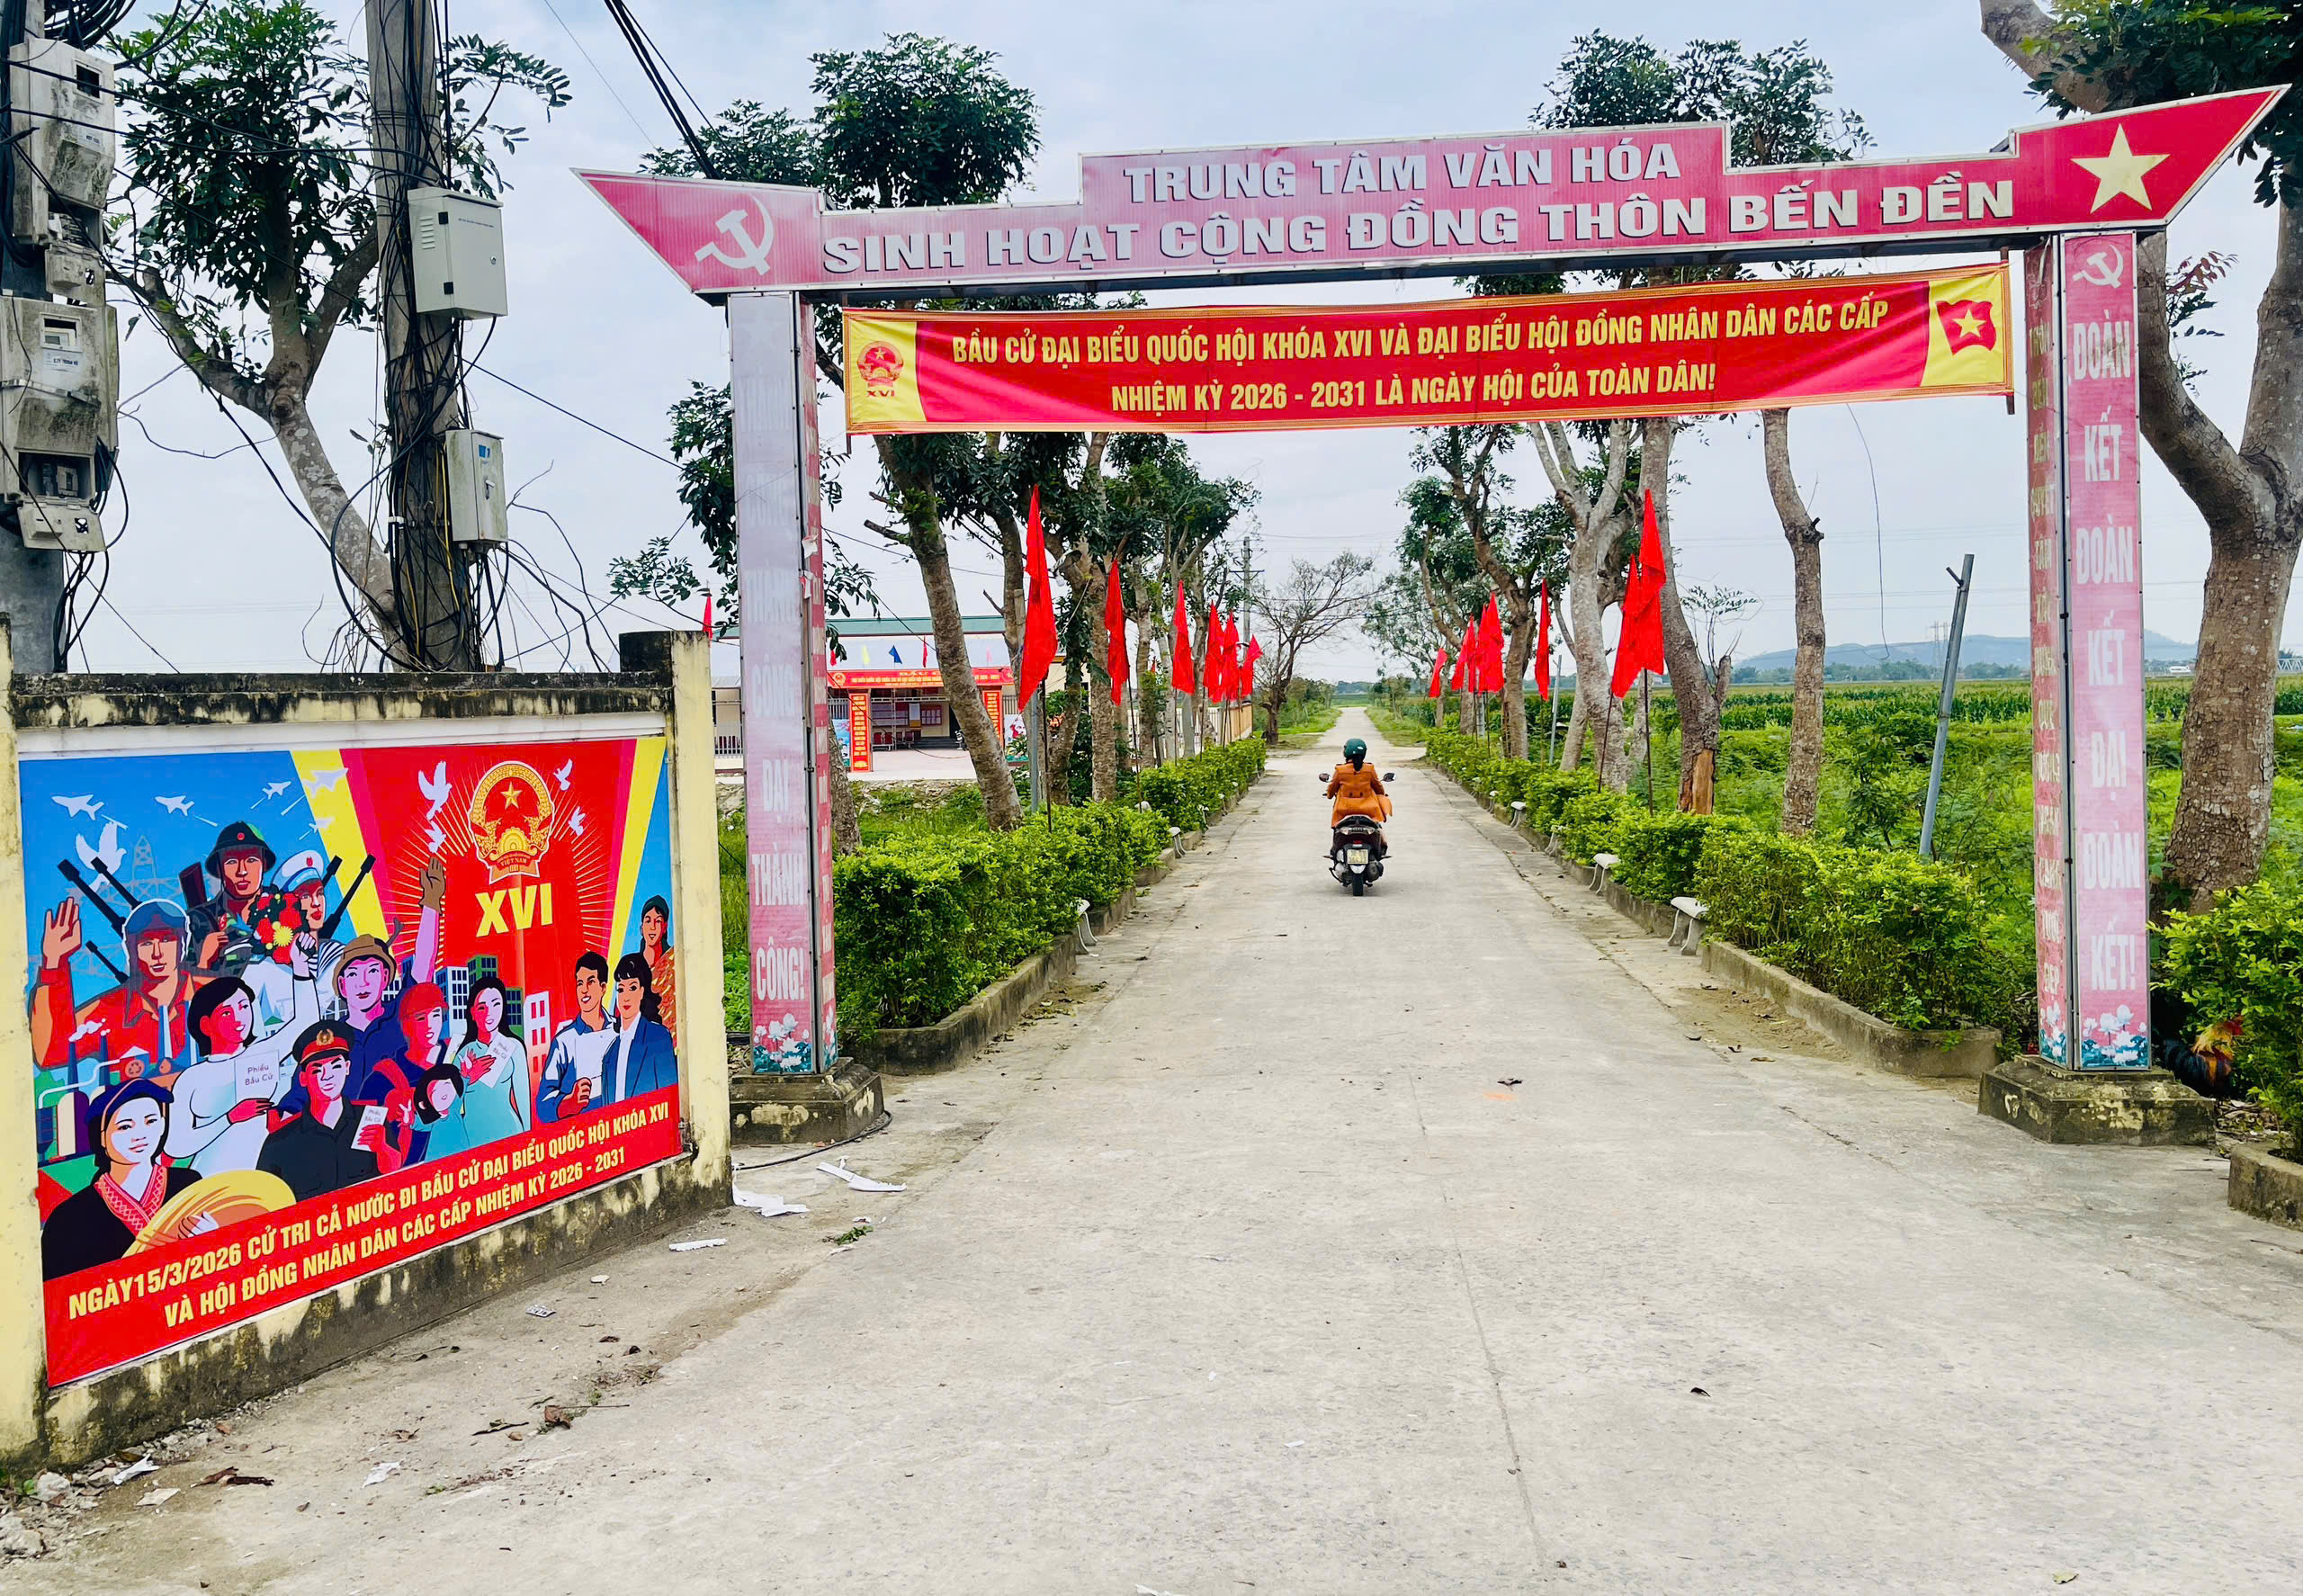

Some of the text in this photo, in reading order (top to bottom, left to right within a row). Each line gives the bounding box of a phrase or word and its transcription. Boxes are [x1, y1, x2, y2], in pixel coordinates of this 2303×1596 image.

[1124, 138, 1681, 203] TRUNG TÂM VĂN HÓA
[823, 171, 2014, 273] SINH HOẠT CỘNG ĐỒNG THÔN BẾN ĐỀN
[952, 291, 1888, 369] BẦU CỬ ĐẠI BIỂU QUỐC HỘI KHÓA XVI VÀ ĐẠI BIỂU HỘI ĐỒNG NHÂN DÂN CÁC CẤP
[2072, 309, 2131, 381] ĐOÀN
[1112, 380, 1187, 417] NHIỆM
[1194, 379, 1223, 411] KỲ
[1231, 382, 1287, 410] 2026
[1311, 381, 1365, 408] 2031
[1376, 373, 1404, 406] LÀ
[1411, 371, 1476, 404] NGÀY
[1483, 368, 1523, 406] HỘI
[1530, 362, 1579, 399] CỦA
[1586, 362, 1650, 397] TOÀN
[1656, 359, 1716, 393] DÂN!
[2083, 405, 2122, 483] KẾT
[2075, 513, 2134, 584] ĐOÀN
[2087, 609, 2126, 686] KẾT
[762, 758, 790, 824] ĐẠI
[2091, 730, 2128, 801] ĐẠI
[751, 841, 806, 906] THÀNH
[2083, 820, 2141, 890] ĐOÀN
[475, 883, 552, 937] XVI
[756, 936, 805, 1001] CÔNG!
[2091, 915, 2137, 991] KẾT!
[245, 1076, 260, 1086] Bầu
[247, 1063, 269, 1074] Phiếu
[247, 1224, 277, 1260] CỬ
[280, 1219, 311, 1249] TRI
[316, 1204, 343, 1237] CẢ
[346, 1192, 395, 1228] NƯỚC
[399, 1185, 417, 1210] ĐI
[421, 1170, 454, 1202] BẦU
[458, 1158, 481, 1188] CỬ
[482, 1154, 508, 1181] ĐẠI
[512, 1138, 545, 1171] BIỂU
[548, 1125, 585, 1160] QUỐC
[587, 1119, 610, 1145] HỘI
[613, 1107, 647, 1136] KHÓA
[649, 1101, 668, 1124] XVI
[164, 1294, 194, 1328] VÀ
[200, 1281, 236, 1316] HỘI
[241, 1261, 298, 1302] ĐỒNG
[302, 1241, 356, 1279] NHÂN
[361, 1226, 398, 1259] DÂN
[402, 1214, 435, 1243] CÁC
[440, 1198, 471, 1229] CẤP
[475, 1181, 524, 1217] NHIỆM
[528, 1170, 546, 1197] KỲ
[550, 1161, 583, 1190] 2026
[595, 1146, 625, 1173] 2031
